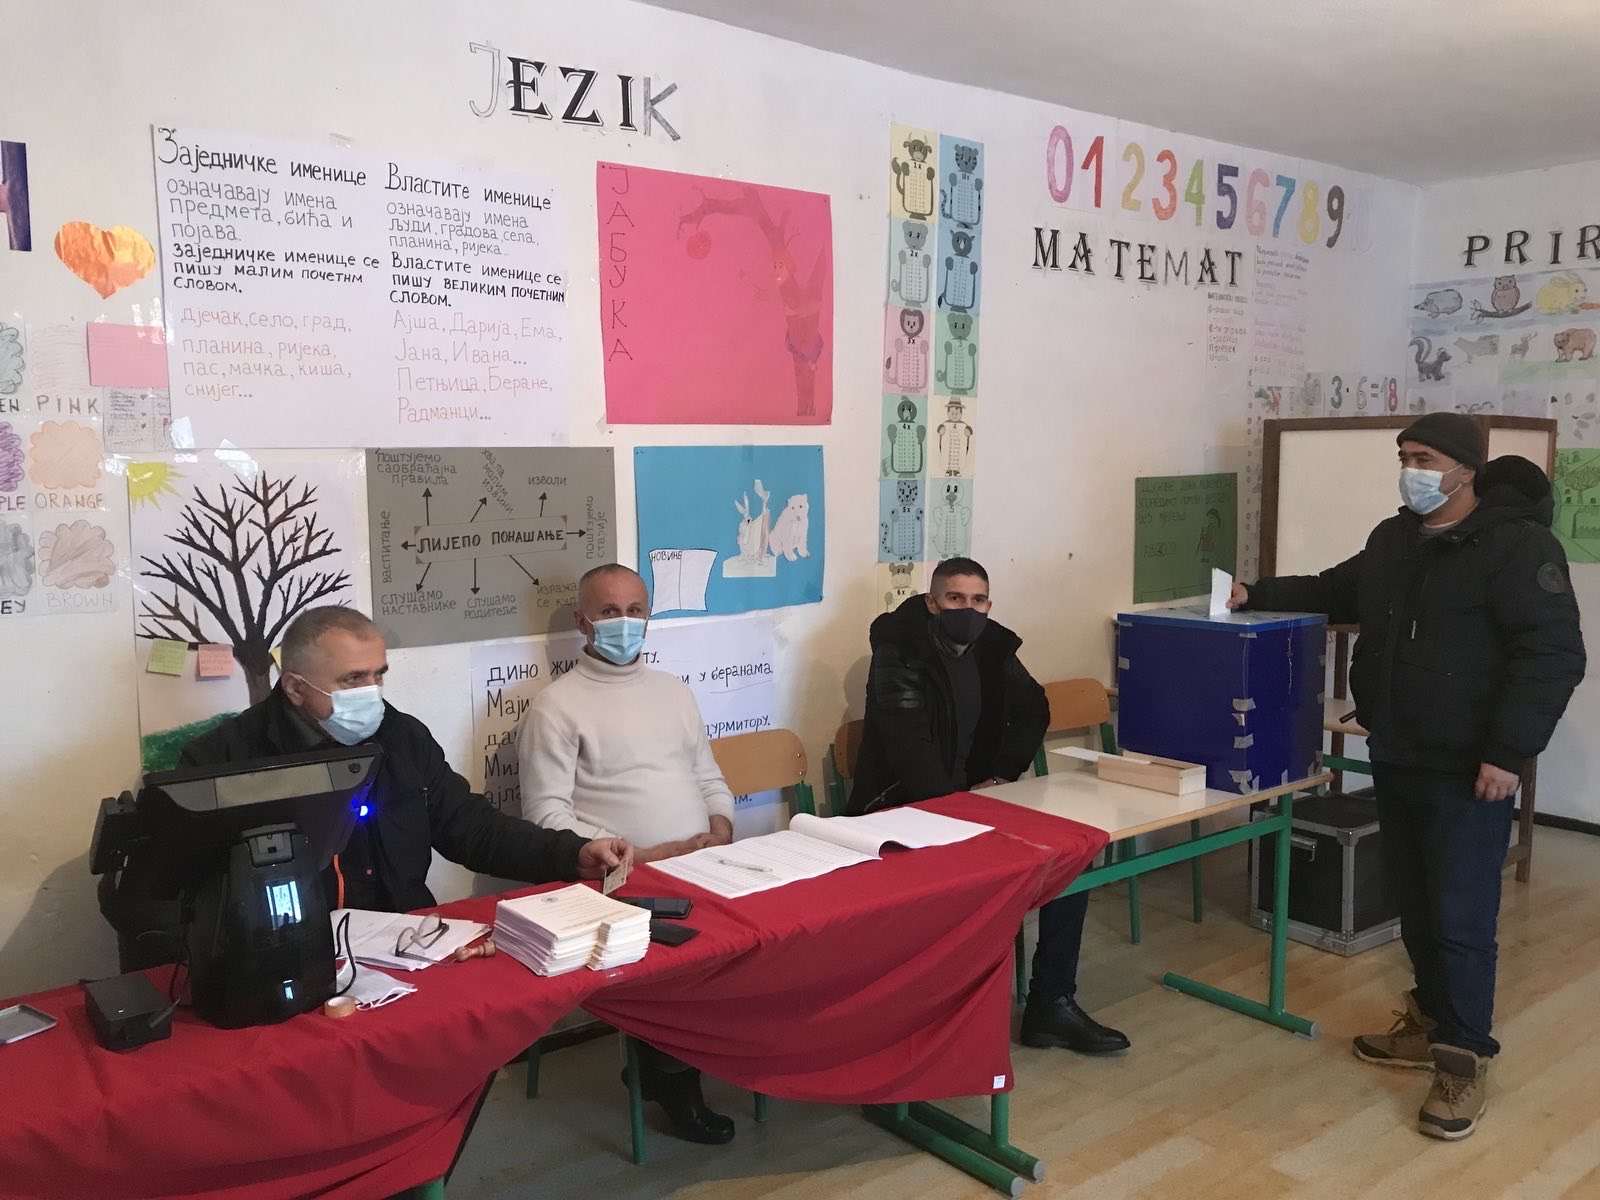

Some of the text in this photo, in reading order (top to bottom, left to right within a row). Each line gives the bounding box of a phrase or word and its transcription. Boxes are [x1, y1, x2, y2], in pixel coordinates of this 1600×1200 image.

[468, 41, 681, 141] JEZIK
[158, 128, 367, 185] Заједничке именице
[167, 179, 337, 210] означавају имена
[384, 162, 552, 211] Властите именице
[341, 215, 353, 229] и
[386, 202, 529, 228] означавају имена
[172, 223, 242, 244] појава.
[1463, 224, 1600, 268] PRIR
[174, 262, 222, 276] пишу
[234, 265, 294, 279] малим
[284, 251, 356, 267] именице
[363, 256, 380, 269] се
[392, 251, 562, 286] Властите именице се
[606, 166, 635, 362] ЈАБУКА
[1031, 227, 1243, 288] MATEMAT
[36, 394, 100, 415] PINK
[34, 492, 104, 510] ORANGE
[417, 529, 565, 554] ЛИЈЕПО ПОНАШАЊЕ
[711, 662, 774, 688] беранама
[484, 731, 517, 751] да
